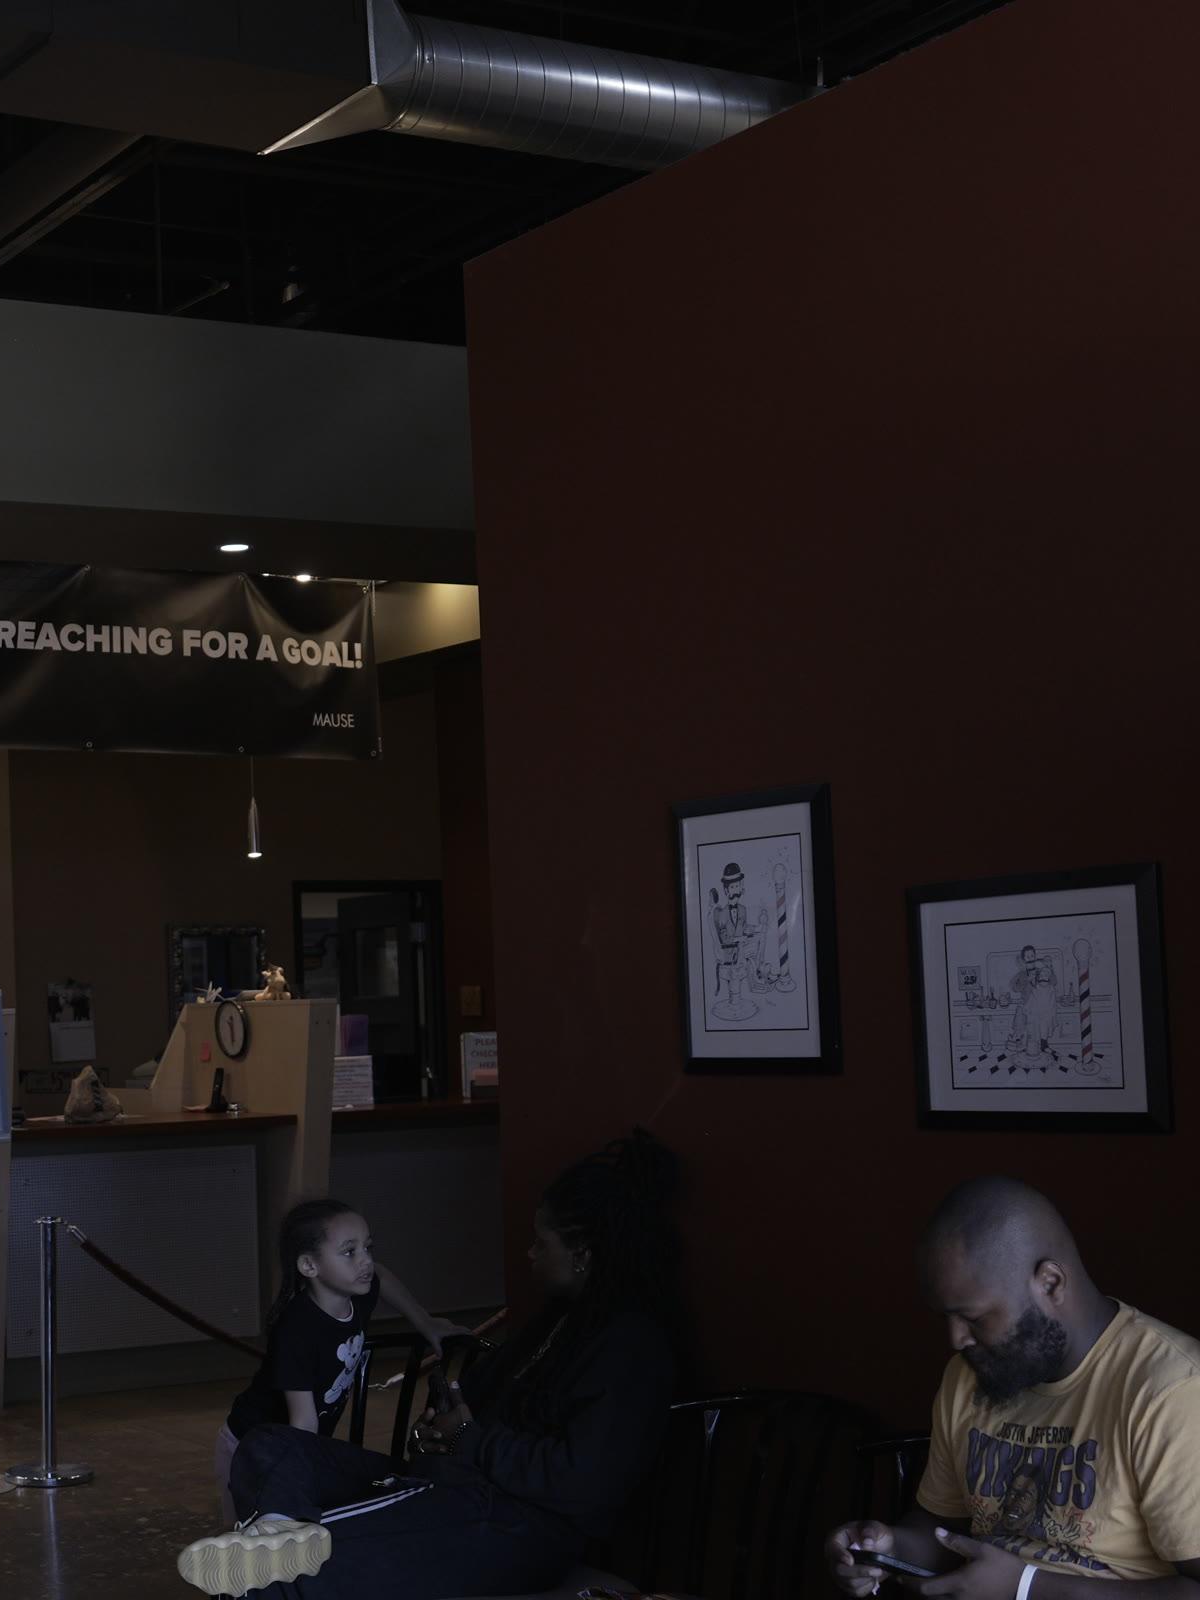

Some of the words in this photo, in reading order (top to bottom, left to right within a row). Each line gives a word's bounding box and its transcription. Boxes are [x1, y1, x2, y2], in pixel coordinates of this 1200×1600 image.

[183, 629, 249, 660] FOR
[256, 635, 278, 662] A
[282, 637, 363, 669] GOAL!
[312, 712, 355, 729] MAUSE
[997, 1423, 1026, 1442] JUSTIN
[1027, 1425, 1074, 1444] JEFFERSON
